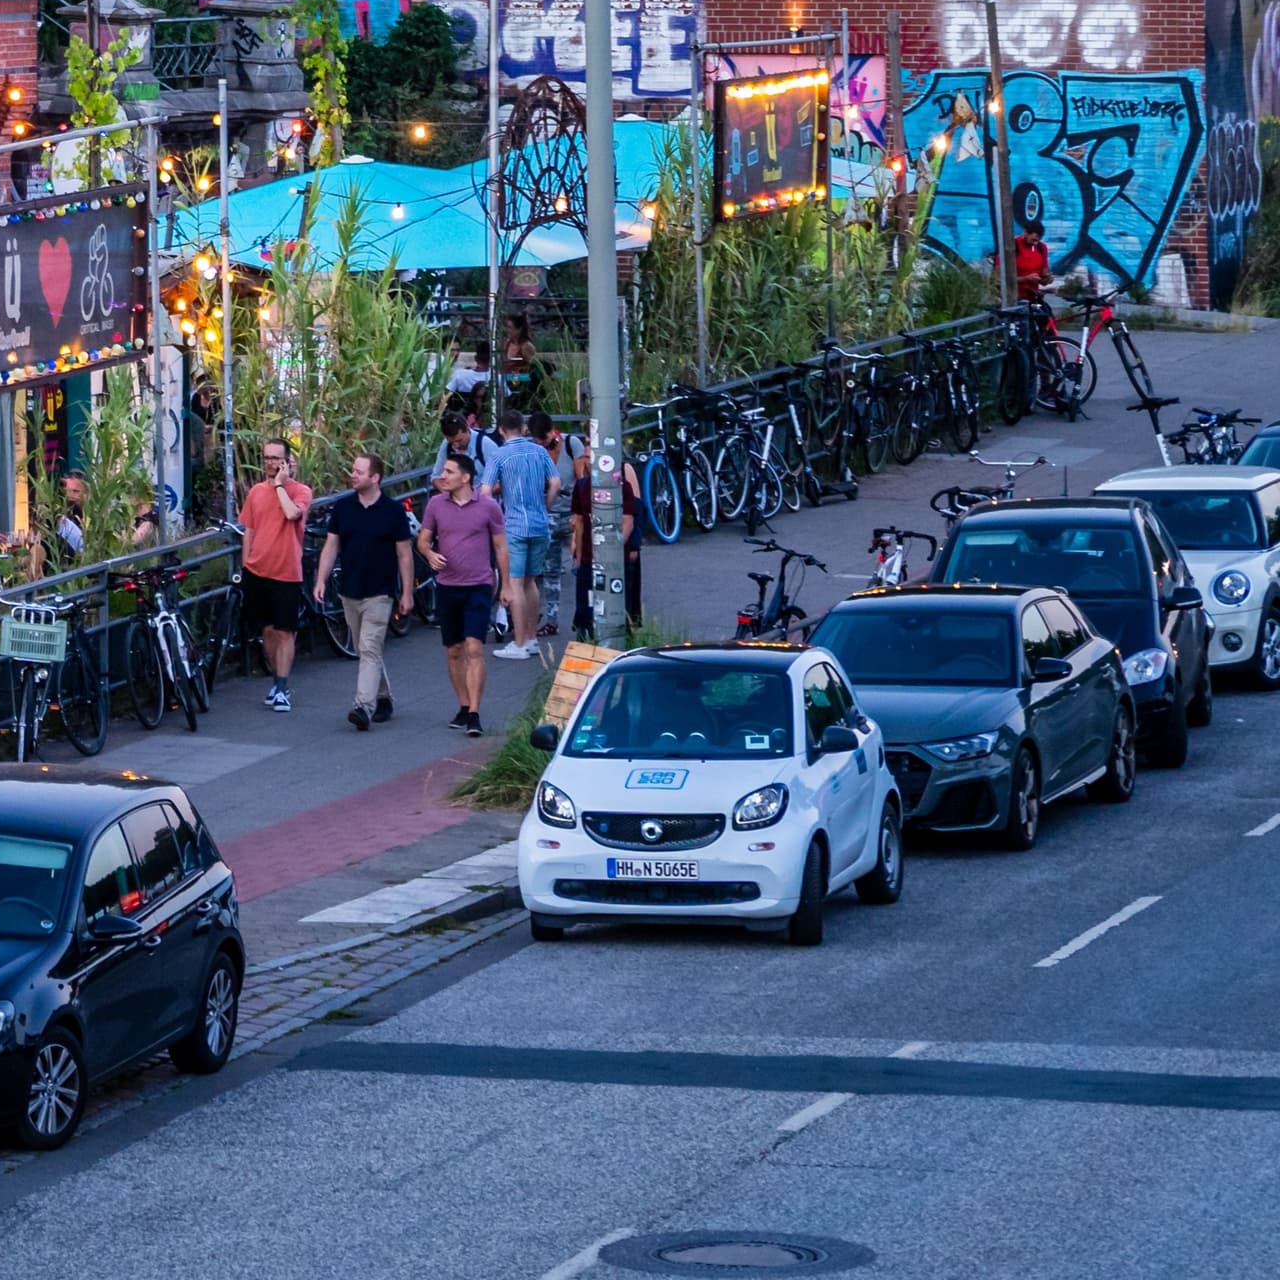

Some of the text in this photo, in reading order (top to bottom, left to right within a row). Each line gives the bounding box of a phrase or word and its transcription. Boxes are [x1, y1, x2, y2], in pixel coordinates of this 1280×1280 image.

[616, 861, 697, 878] HH N 5065E
